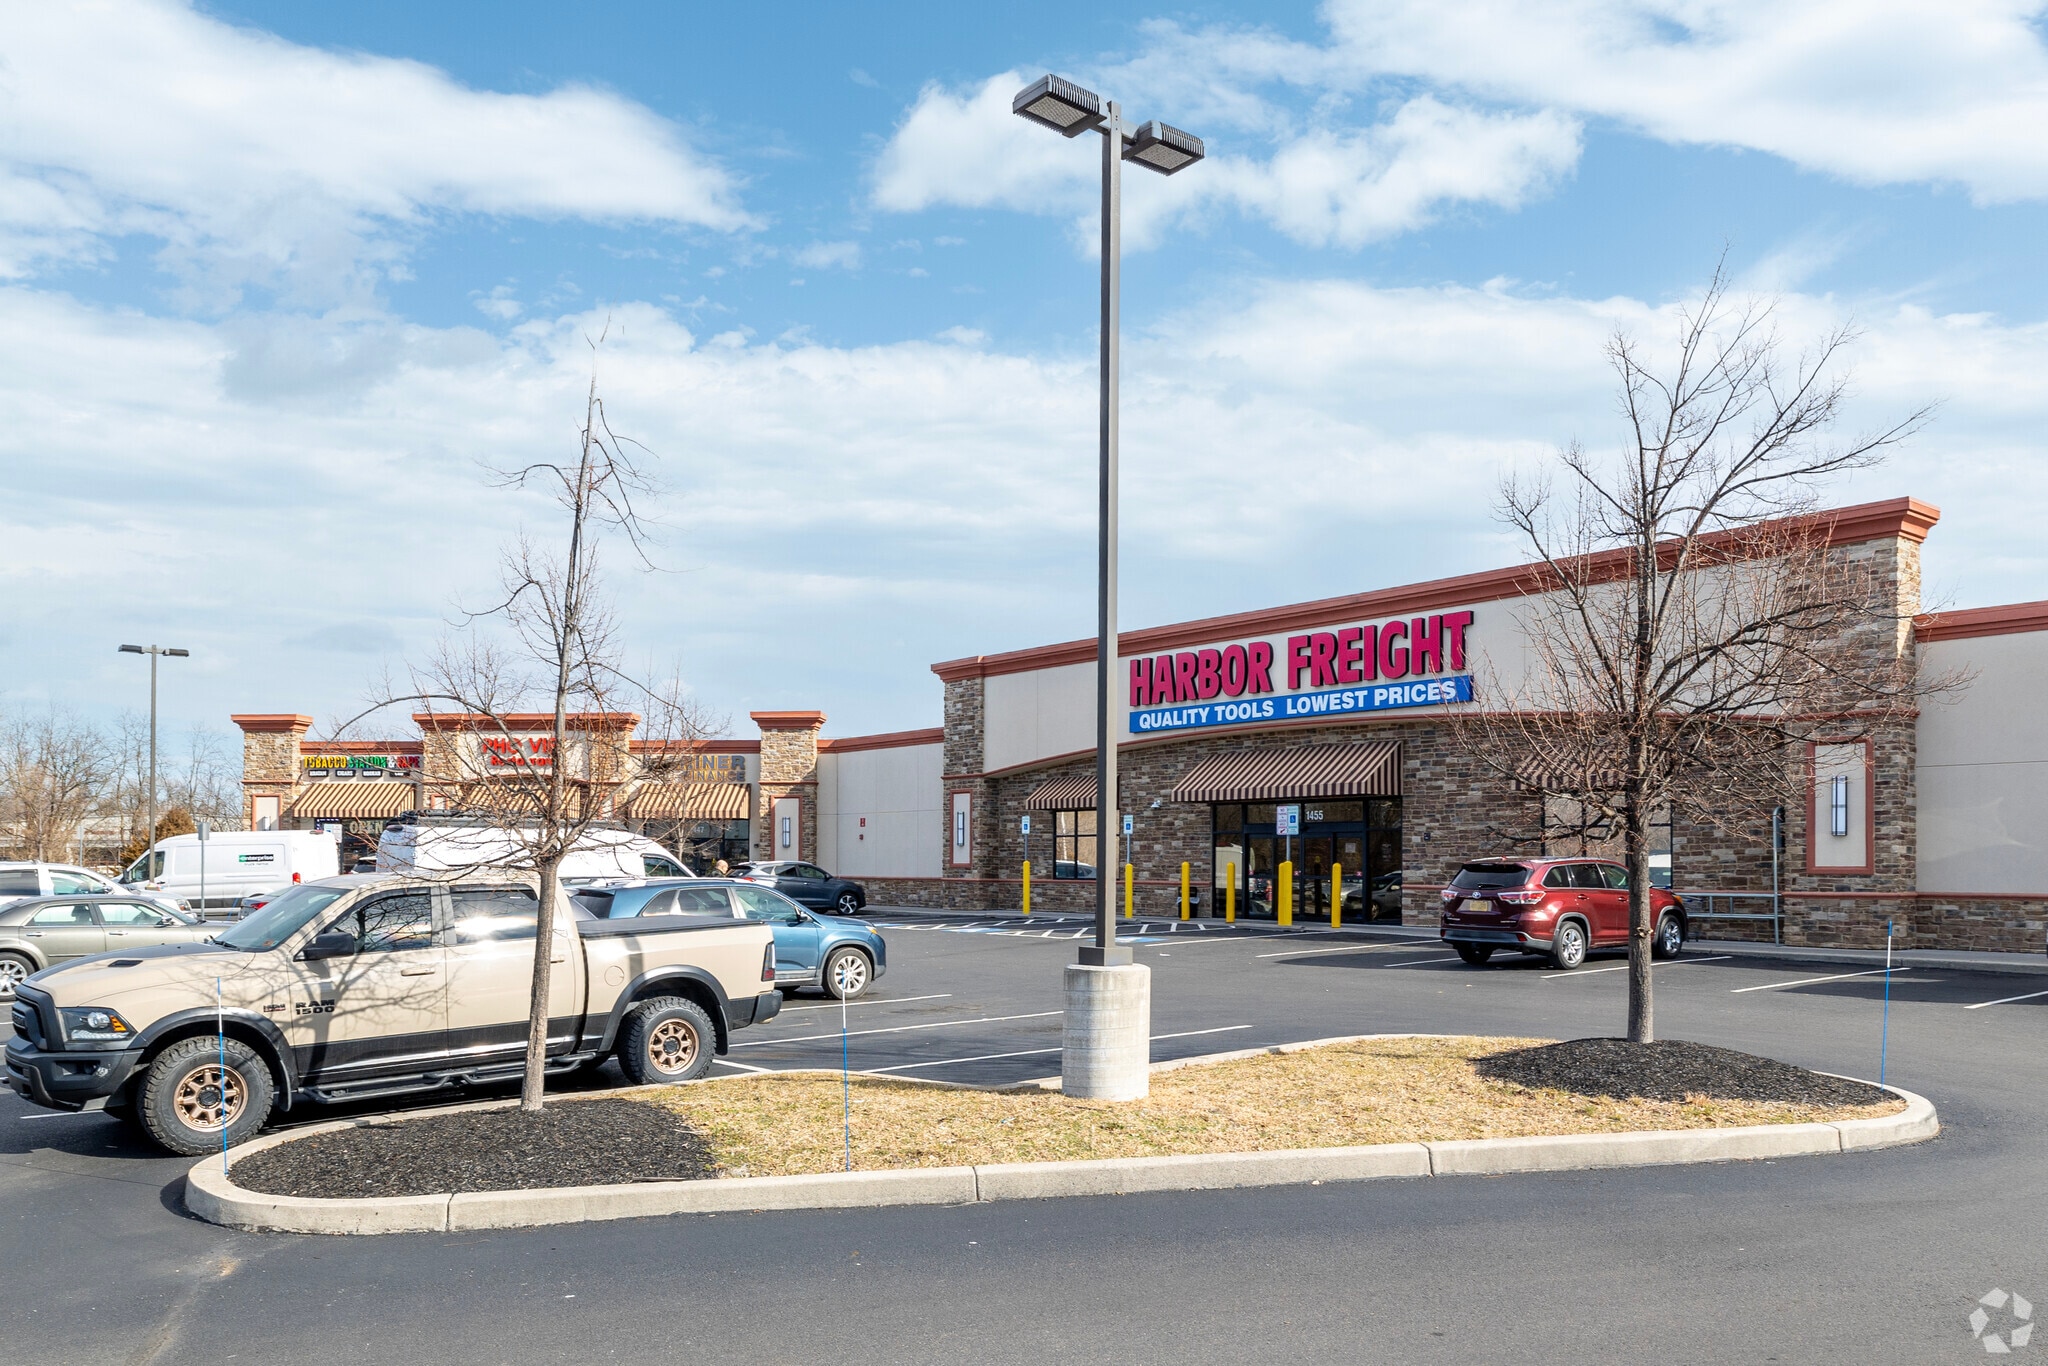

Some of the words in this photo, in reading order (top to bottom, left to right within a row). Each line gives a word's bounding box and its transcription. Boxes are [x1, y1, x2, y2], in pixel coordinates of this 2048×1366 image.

[1129, 641, 1273, 707] HARBOR
[1287, 610, 1474, 690] FREIGHT
[1139, 707, 1210, 730] QUALITY
[1214, 699, 1274, 722] TOOLS
[1286, 690, 1369, 715] LOWEST
[1374, 680, 1457, 706] PRICES
[482, 737, 522, 754] PHO
[303, 755, 347, 769] TOBACCO
[348, 755, 388, 769] STATION
[388, 756, 395, 768] &
[397, 755, 420, 769] VAPE
[1305, 810, 1324, 820] 1455
[349, 820, 384, 834] OPEN
[295, 999, 335, 1008] RAM
[295, 1006, 335, 1015] 1500
